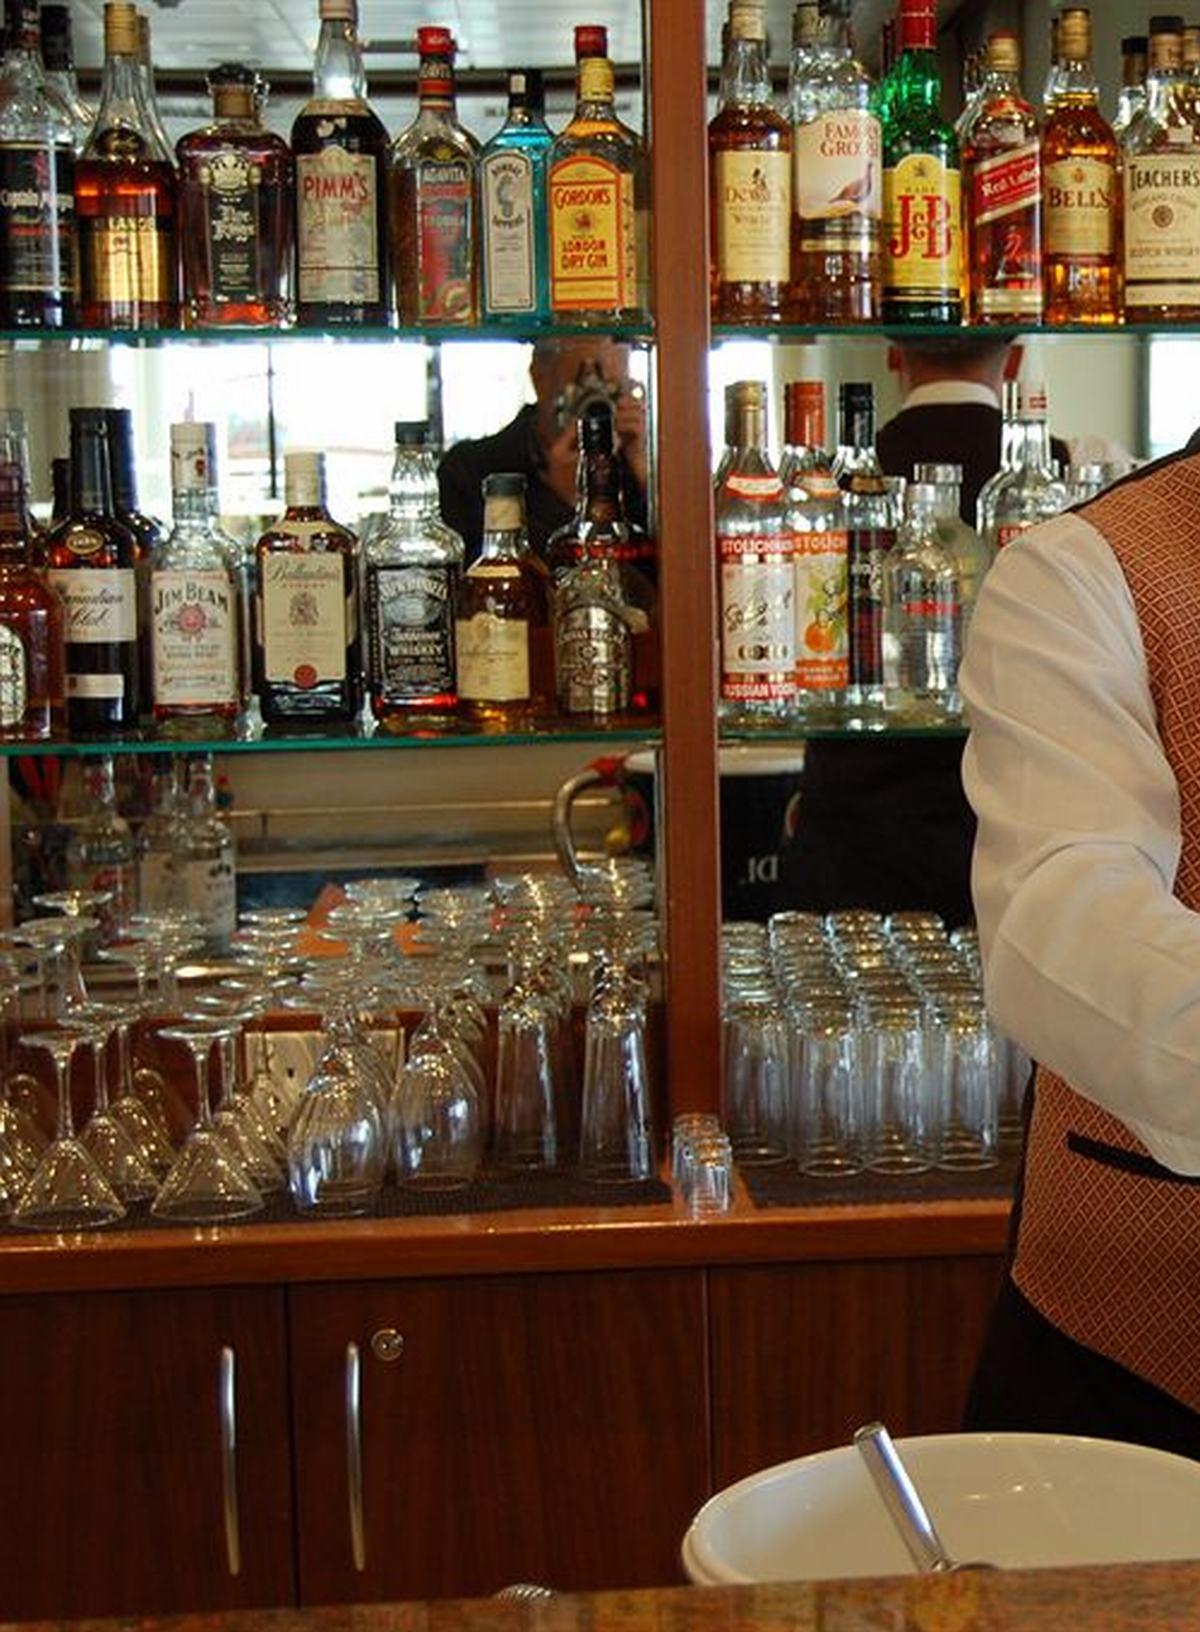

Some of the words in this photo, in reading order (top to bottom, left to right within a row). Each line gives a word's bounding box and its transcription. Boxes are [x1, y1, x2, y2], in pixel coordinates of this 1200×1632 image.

[823, 122, 879, 139] FAM
[820, 141, 879, 157] GRO
[303, 171, 368, 199] PIMM'S
[1129, 164, 1200, 191] TEACHER'S
[1049, 186, 1111, 209] BELL'S
